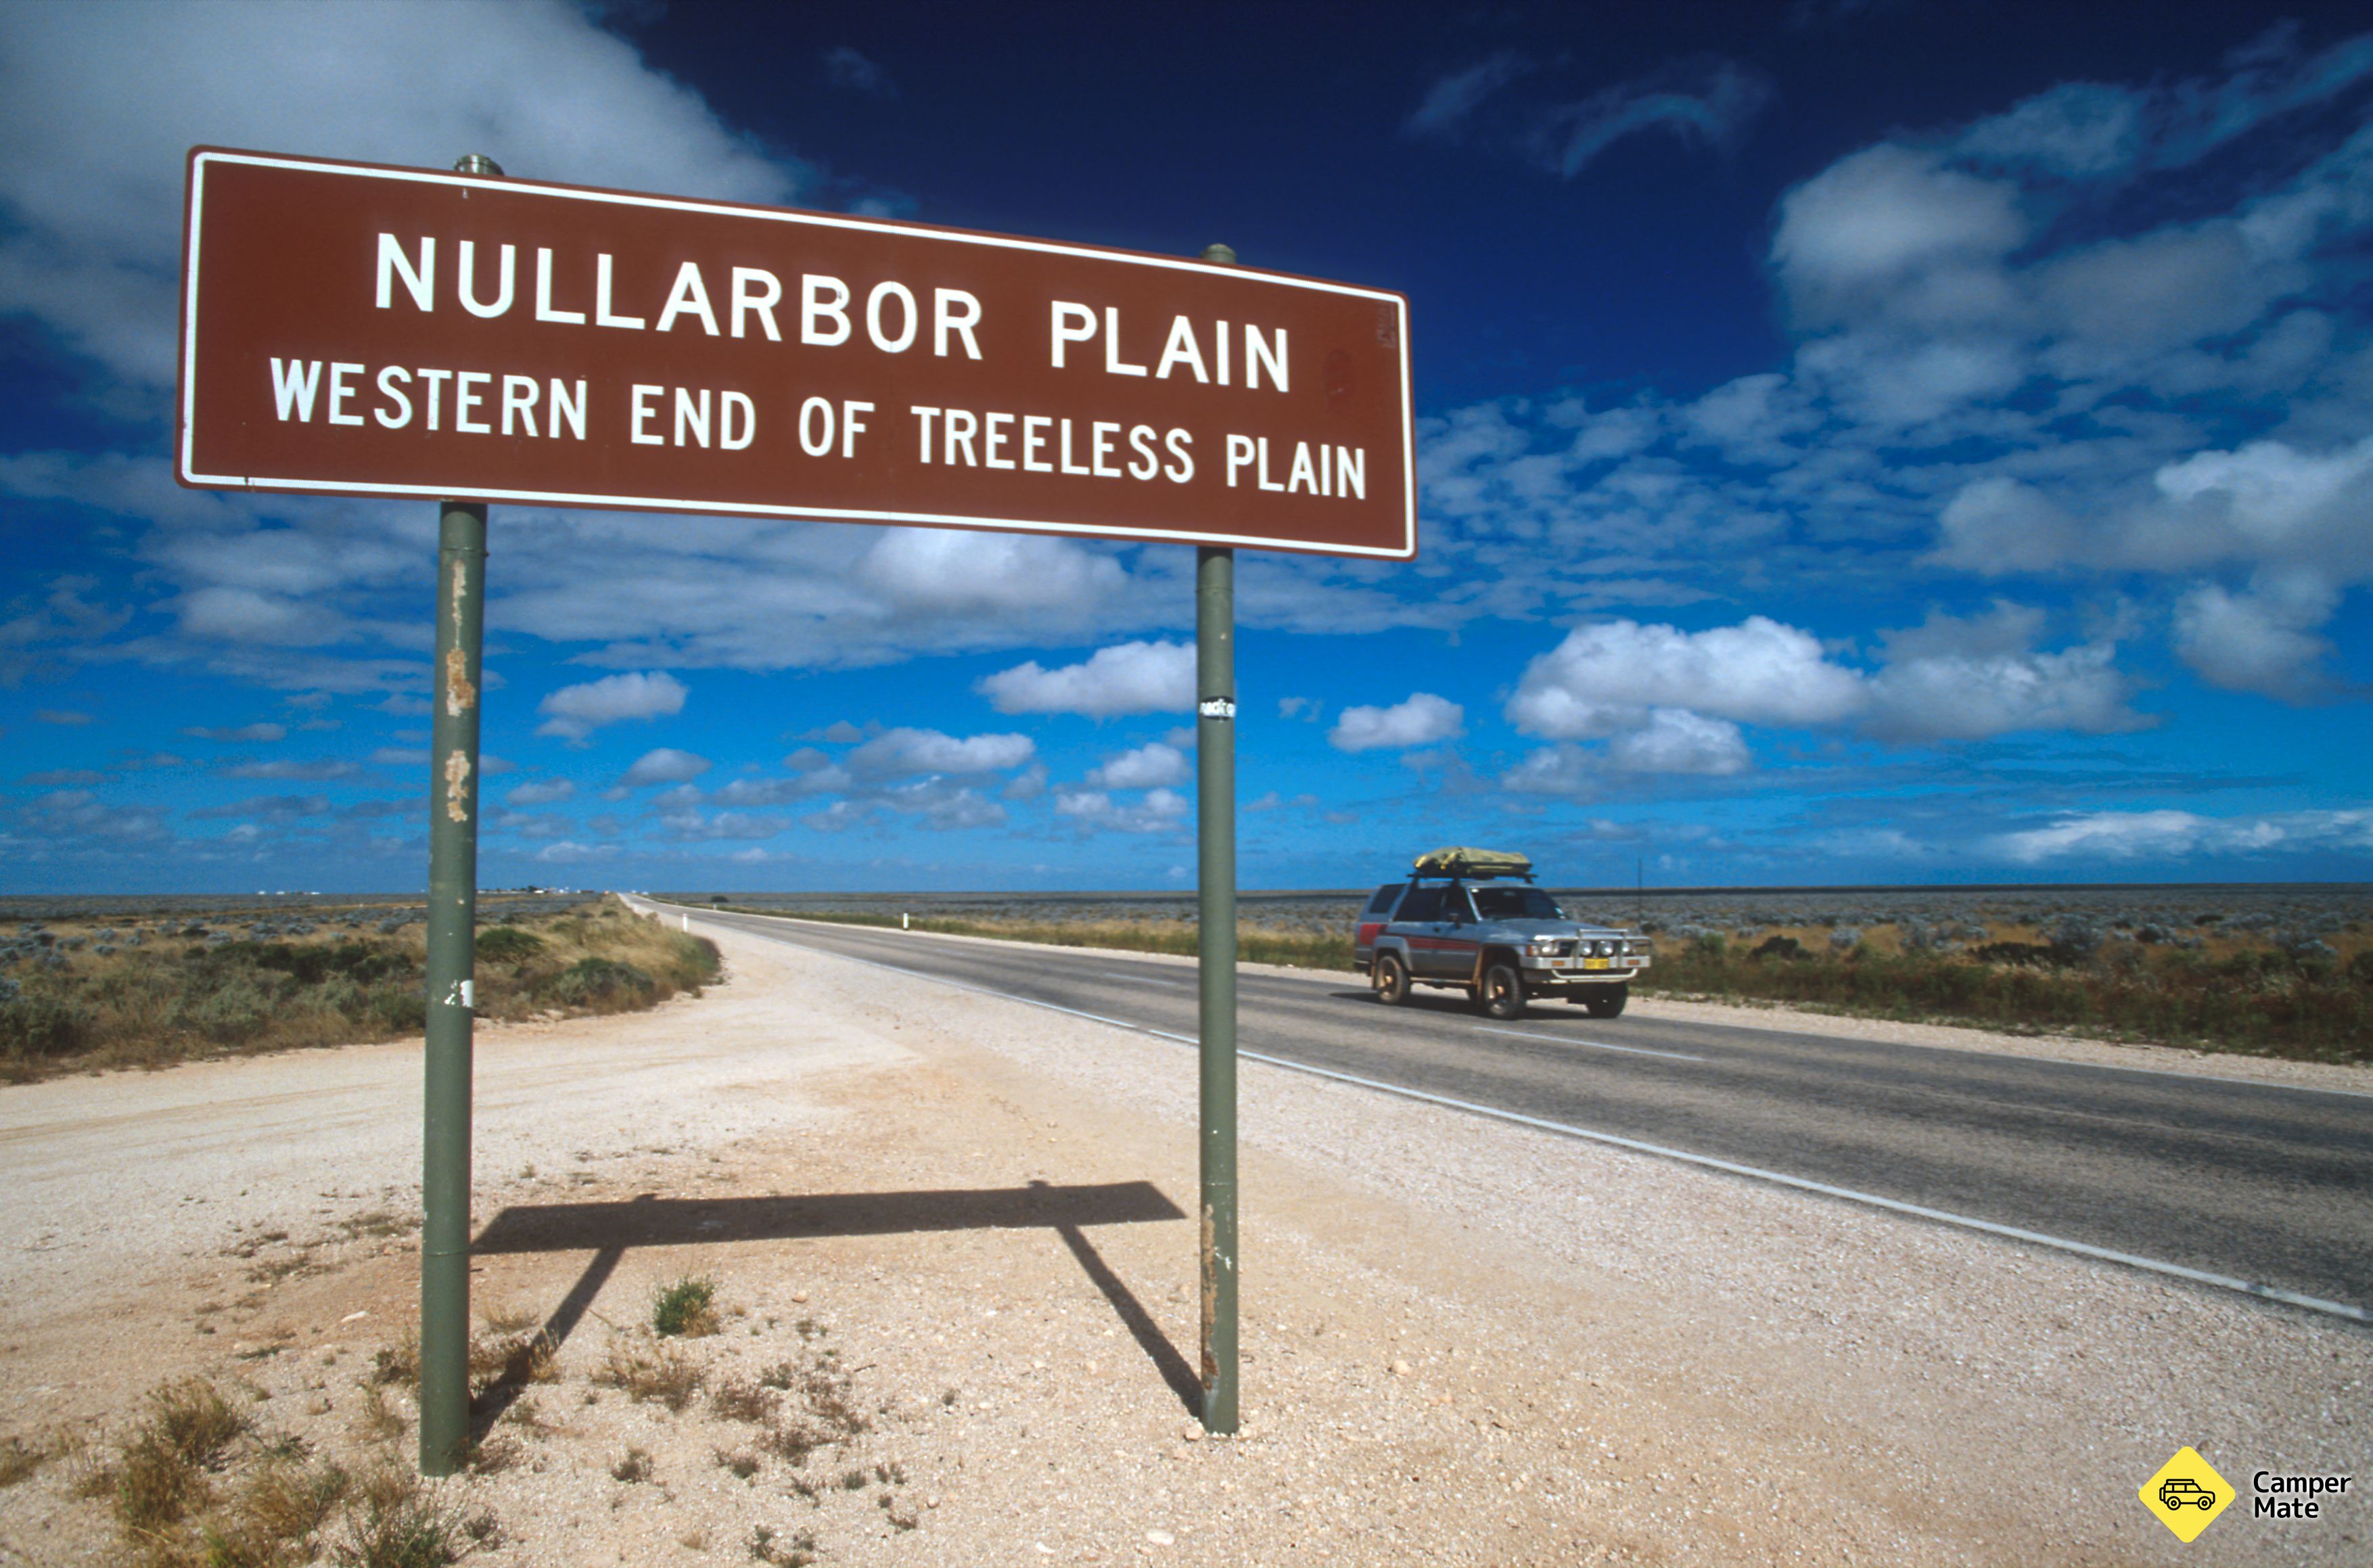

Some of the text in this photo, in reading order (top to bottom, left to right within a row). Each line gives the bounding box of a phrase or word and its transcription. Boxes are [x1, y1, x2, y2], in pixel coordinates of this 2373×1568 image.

[375, 232, 1289, 393] NULLARBOR PLAIN
[270, 357, 1365, 500] WESTERN END OF TREELESS PLAIN
